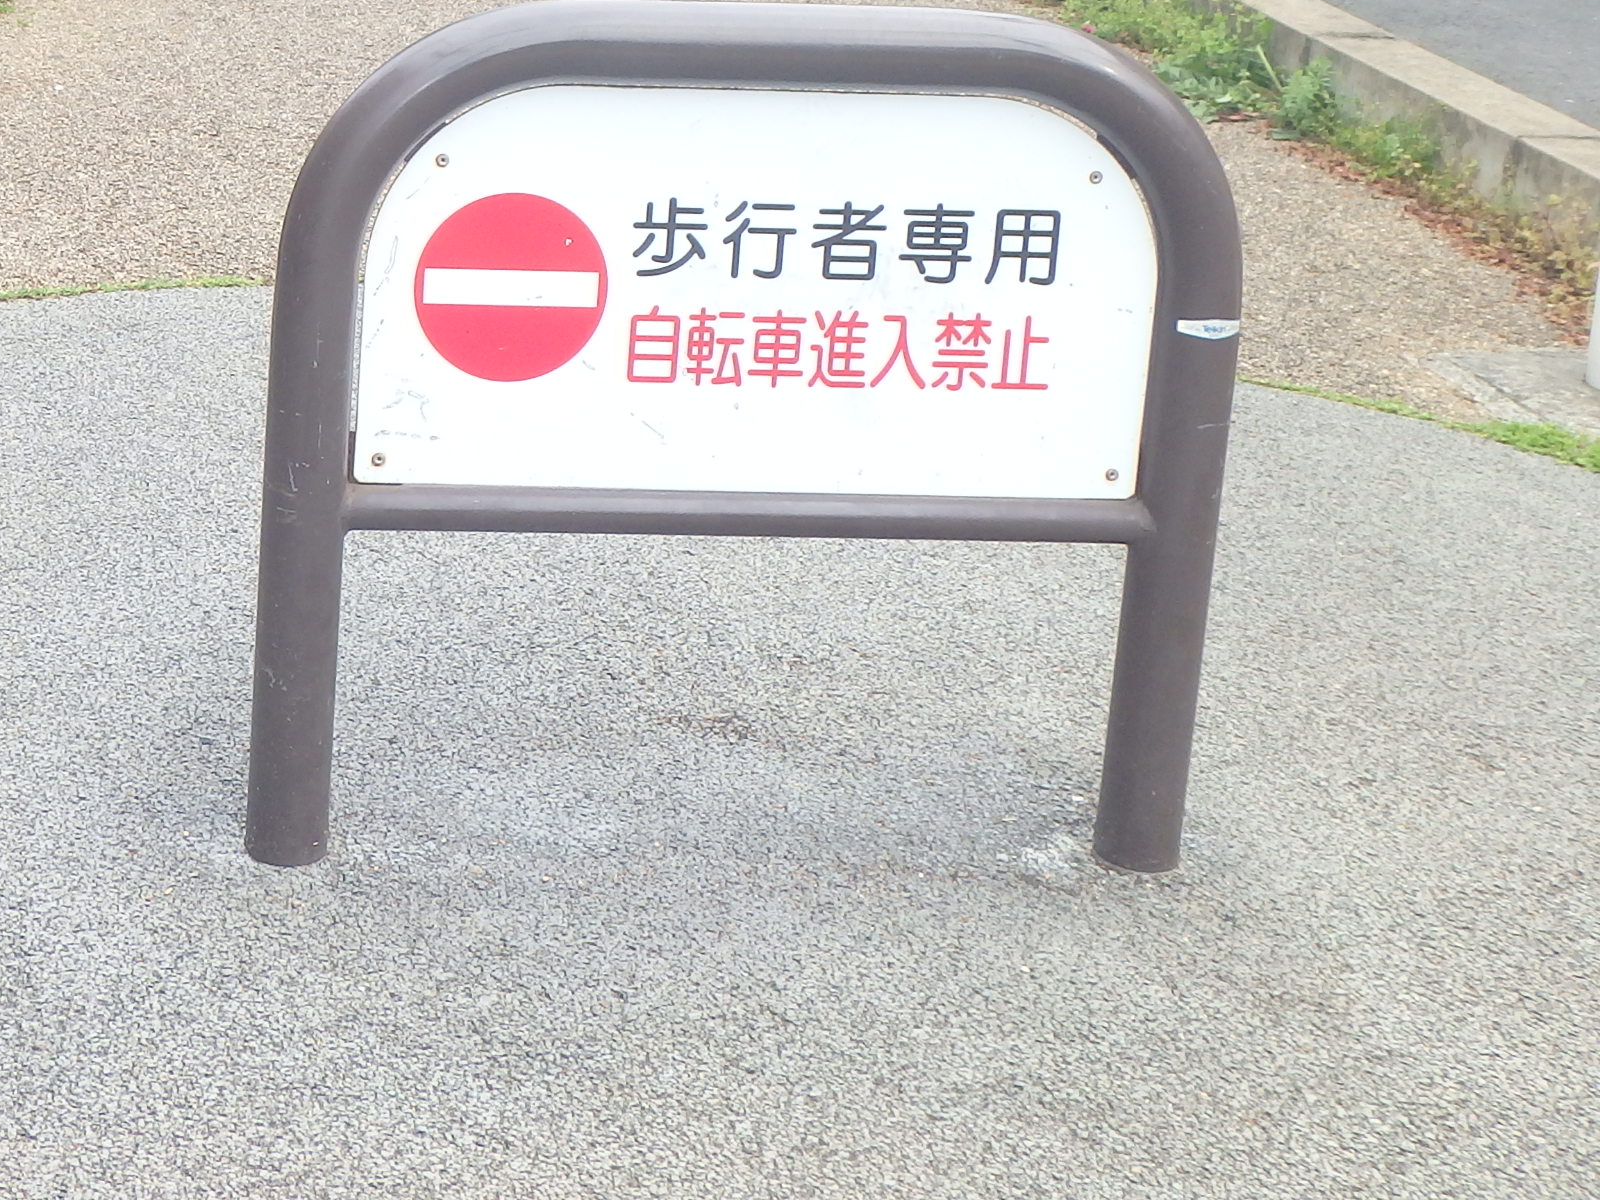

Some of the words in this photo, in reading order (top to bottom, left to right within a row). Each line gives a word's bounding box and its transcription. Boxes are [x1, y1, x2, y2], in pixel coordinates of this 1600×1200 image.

[630, 196, 1062, 287] 歩行者専用
[625, 305, 1051, 392] 自転車進入禁止
